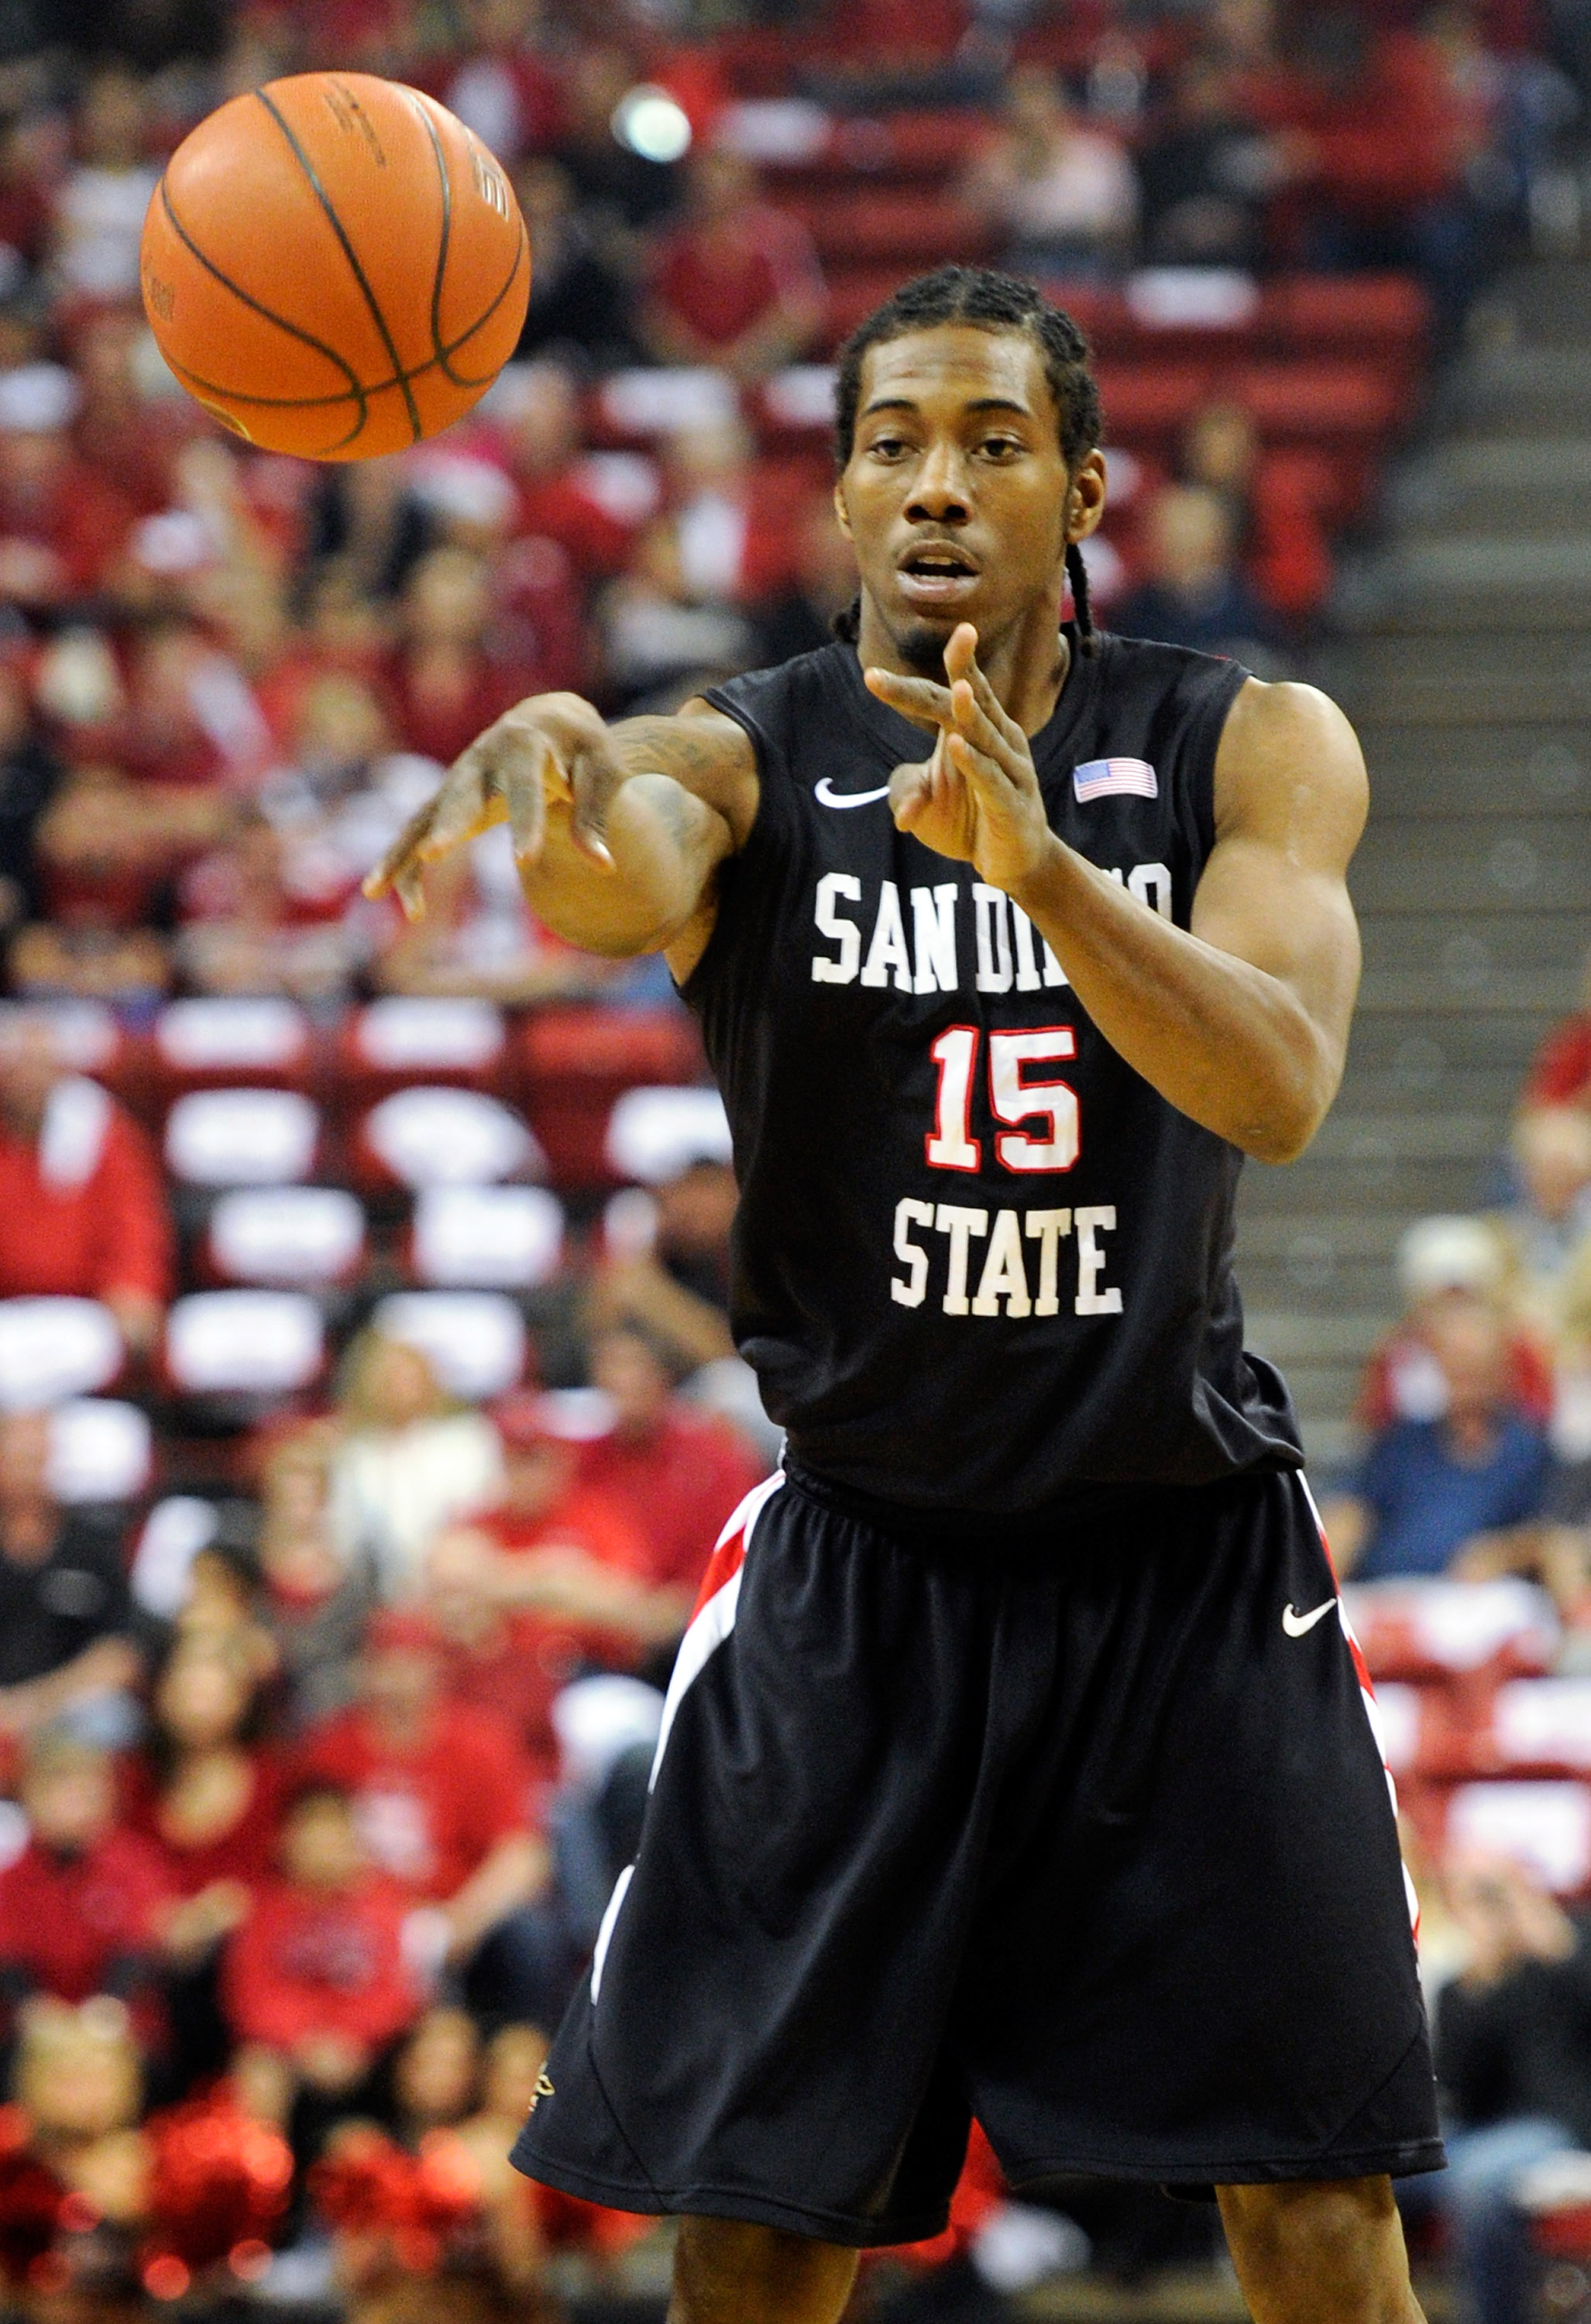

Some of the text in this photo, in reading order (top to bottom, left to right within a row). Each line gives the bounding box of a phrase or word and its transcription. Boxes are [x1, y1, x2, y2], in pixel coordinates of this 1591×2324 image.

[812, 862, 1173, 995] SAN DIO
[925, 1024, 1081, 1174] 15
[891, 1197, 1124, 1318] STATE
